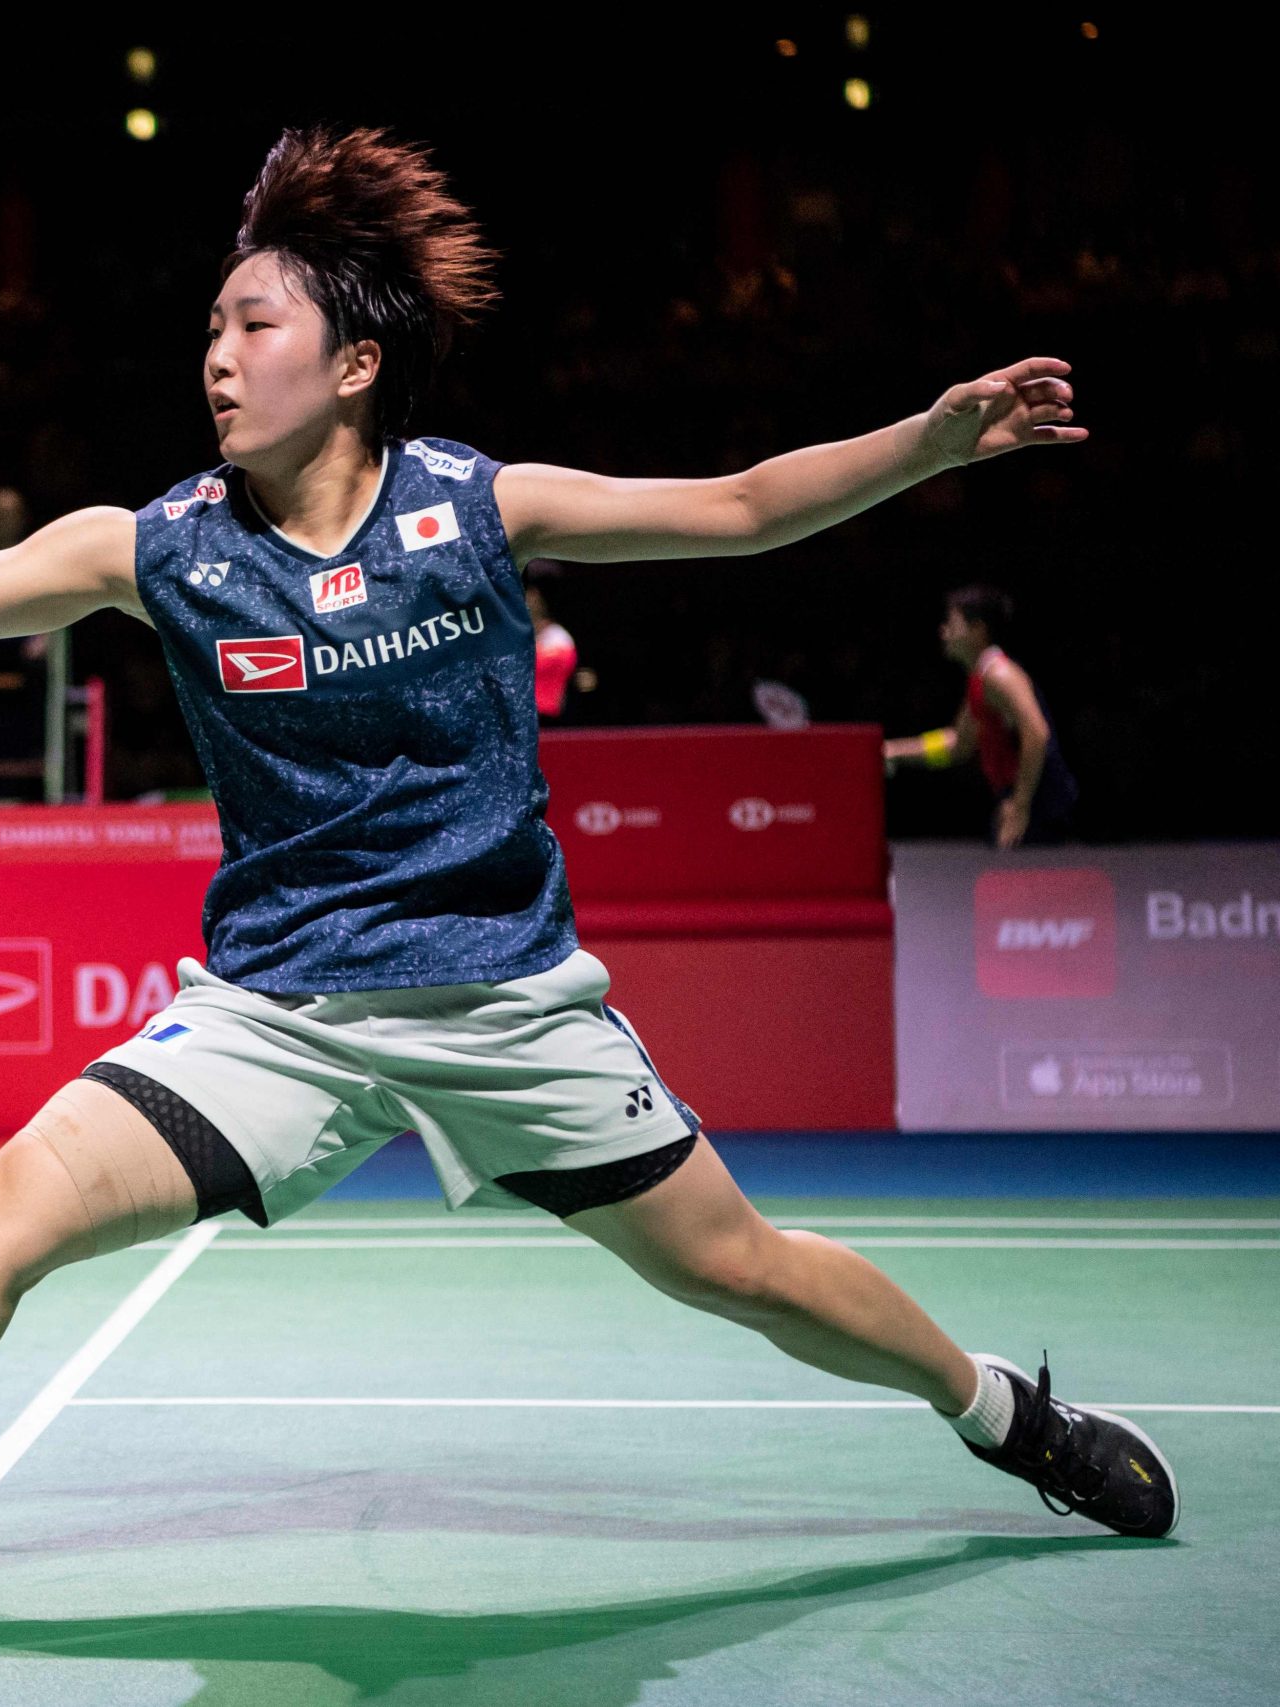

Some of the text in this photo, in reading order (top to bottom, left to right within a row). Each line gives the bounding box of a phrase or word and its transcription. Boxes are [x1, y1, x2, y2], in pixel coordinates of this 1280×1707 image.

[316, 566, 361, 604] JTB
[317, 593, 364, 611] SPORTS
[313, 607, 485, 675] DAIHATSU
[74, 963, 175, 1028] DA
